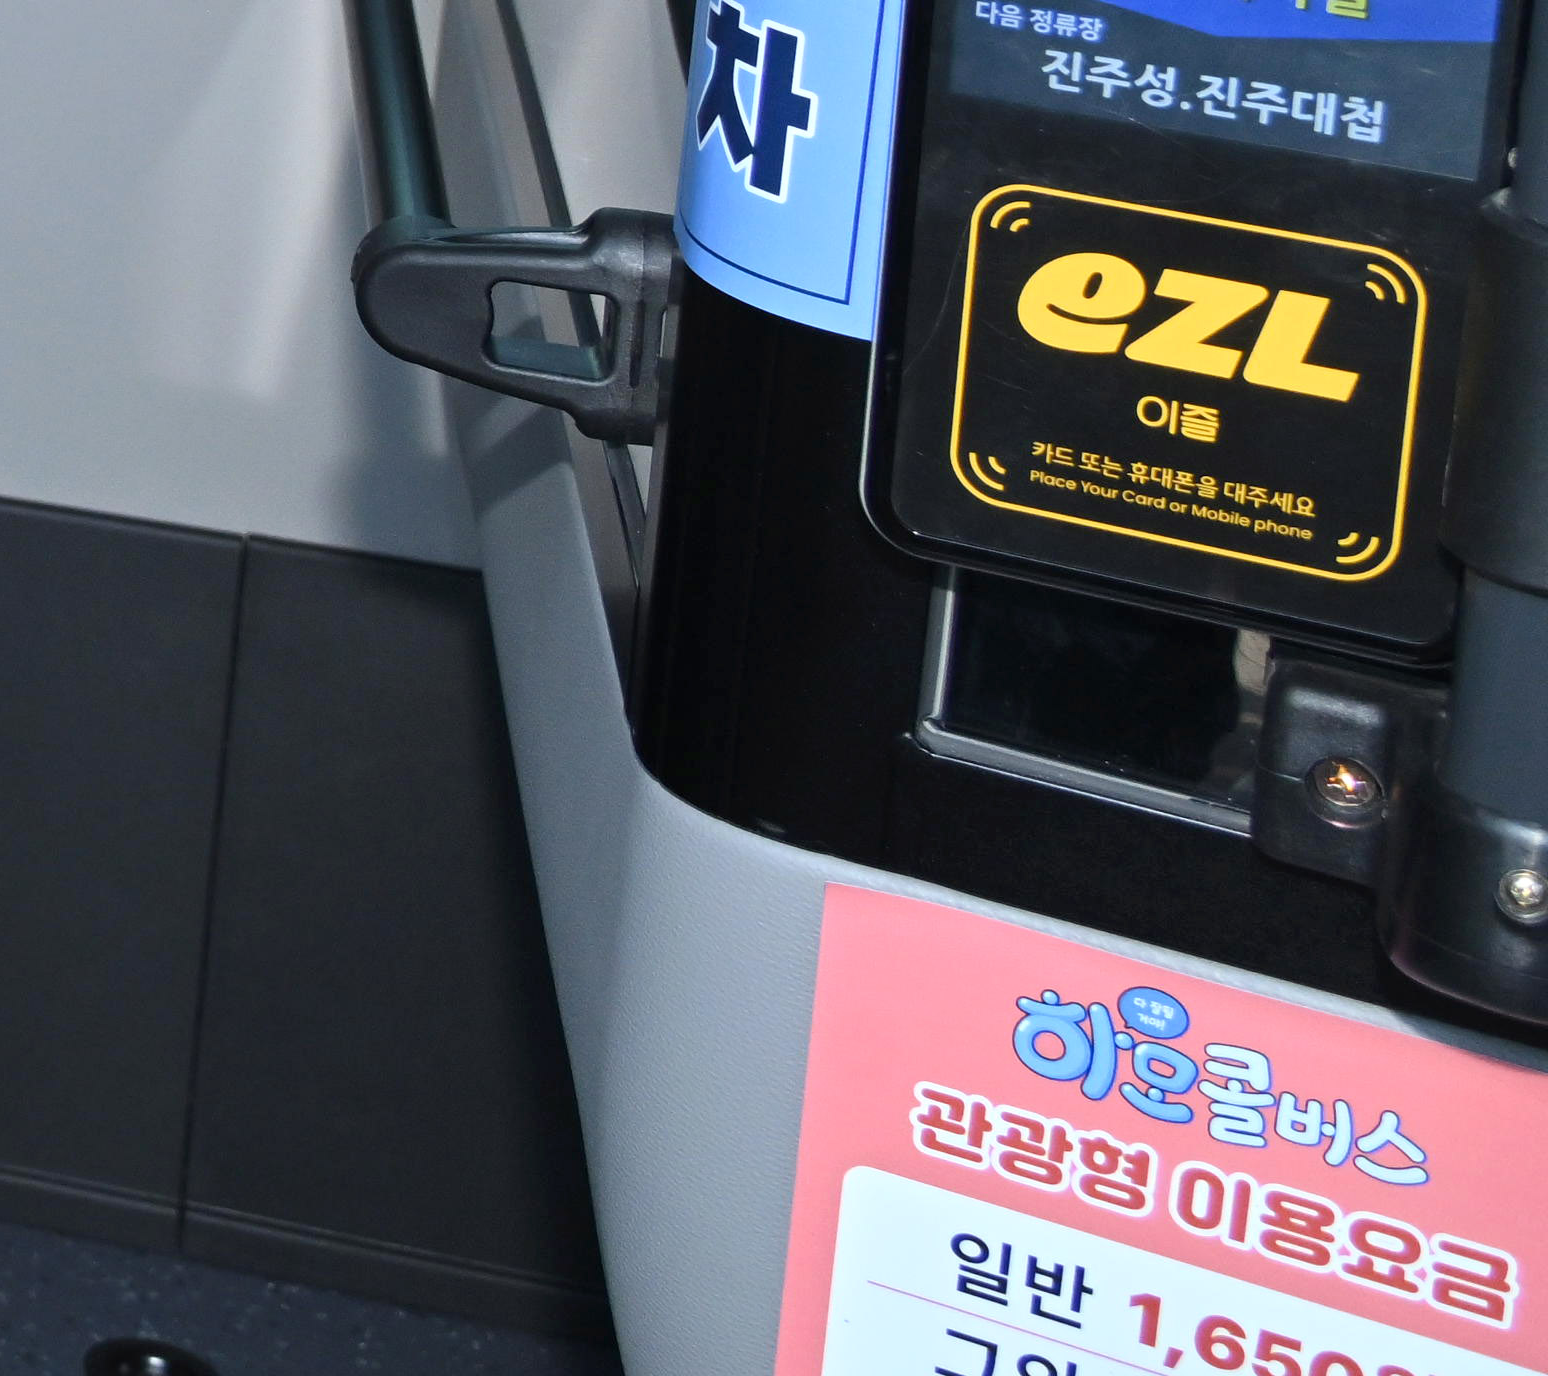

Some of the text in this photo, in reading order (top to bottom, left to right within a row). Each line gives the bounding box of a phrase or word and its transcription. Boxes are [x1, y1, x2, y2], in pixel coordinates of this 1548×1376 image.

[975, 0, 1104, 42] 다음 정류장
[1041, 49, 1386, 145] 진주성.진주대첩
[1136, 395, 1220, 443] 이즐
[1030, 469, 1313, 540] Place Your Card or Mobile phone
[1031, 441, 1316, 518] 카드 또는 휴대폰을 대주세요
[917, 1087, 1513, 1322] 관광형 이용요금
[950, 1232, 1094, 1330] 일반
